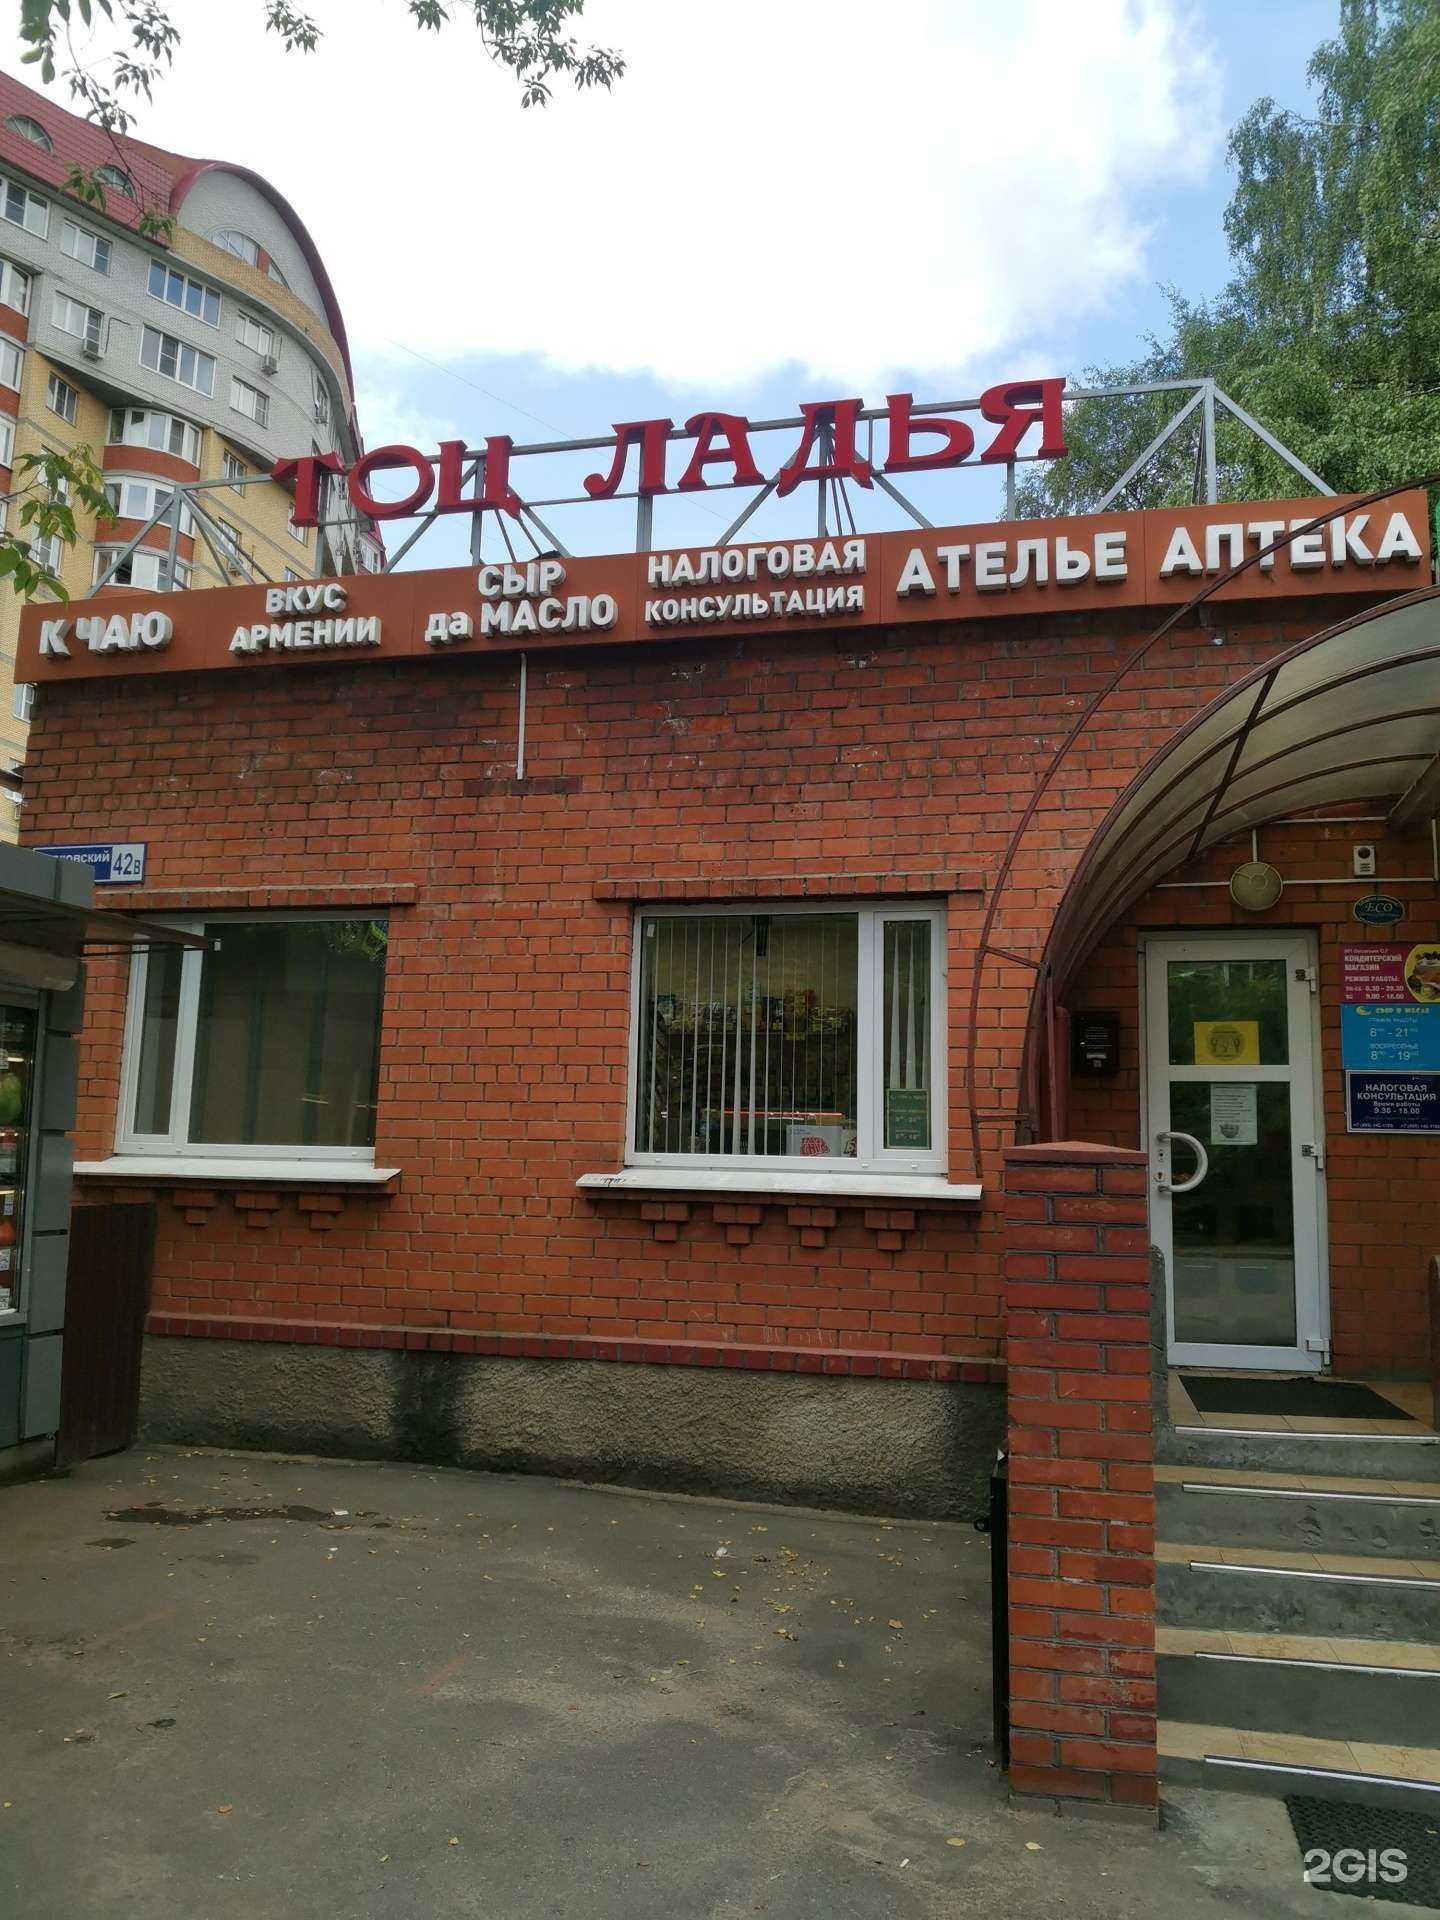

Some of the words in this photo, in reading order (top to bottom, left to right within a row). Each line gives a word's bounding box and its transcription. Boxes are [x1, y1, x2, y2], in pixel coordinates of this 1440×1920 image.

[271, 434, 521, 528] ТОЦ
[583, 377, 1069, 498] ЛАДЬЯ
[647, 539, 866, 588] НАЛОГОВАЯ
[896, 531, 1128, 597] АТЕЛЬЕ
[1160, 511, 1424, 578] АПТЕКА
[265, 583, 348, 616] ВКУС
[477, 560, 566, 599] СЫР
[424, 611, 473, 645] да
[480, 593, 618, 638] МАСЛО
[644, 585, 864, 627] КОНСУЛЬТАЦИЯ
[38, 619, 71, 657] К
[75, 610, 174, 653] ЧАЮ
[228, 616, 382, 654] АРМЕНИИ
[1357, 1092, 1437, 1101] КОНСУЛЬТАЦИЯ
[1365, 1083, 1428, 1092] НАЛОГОВАЯ
